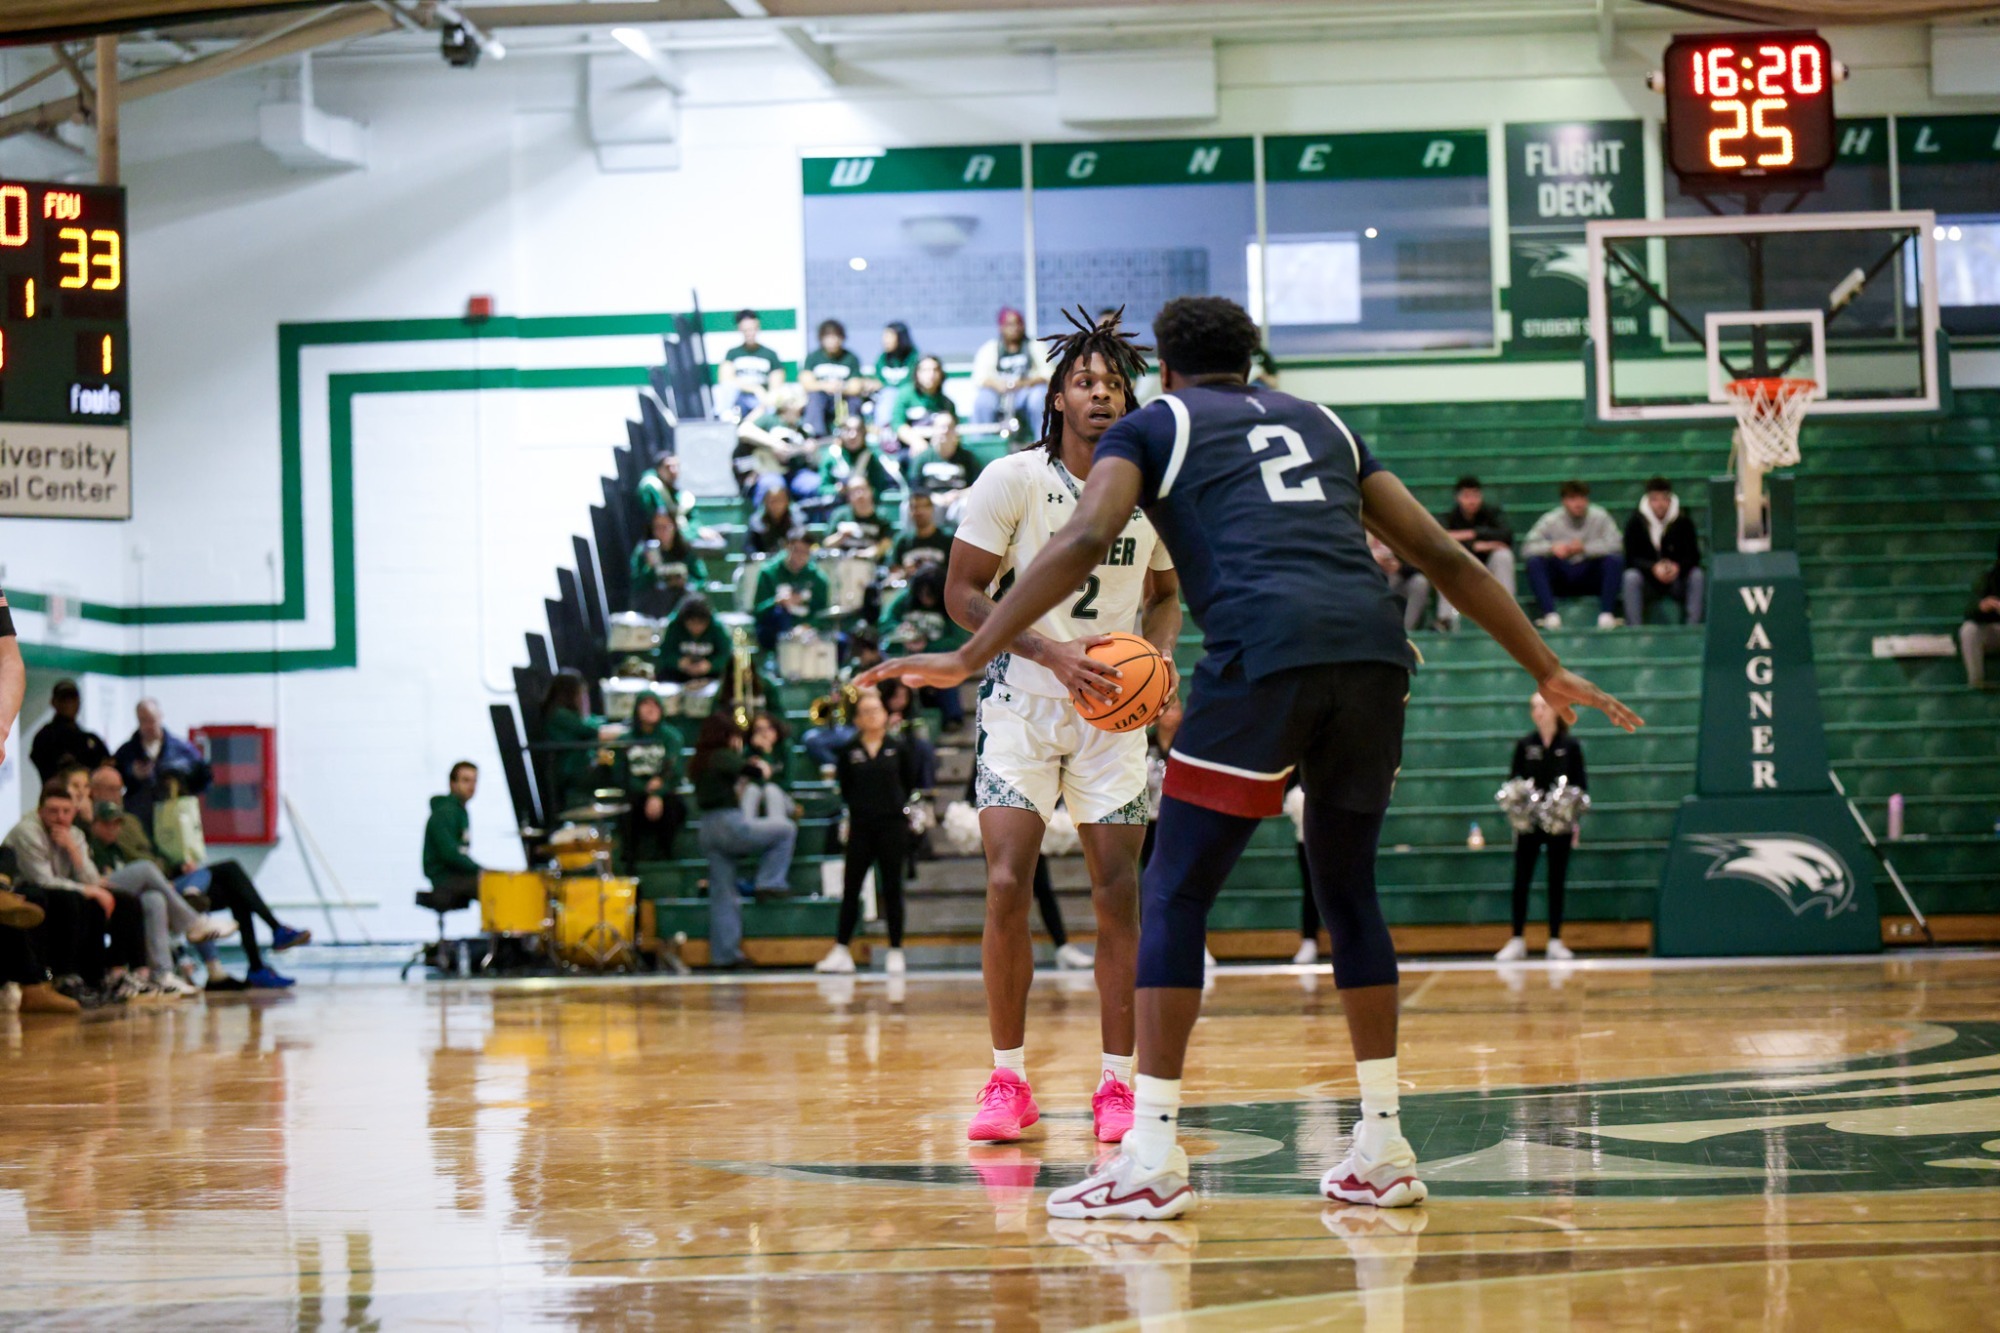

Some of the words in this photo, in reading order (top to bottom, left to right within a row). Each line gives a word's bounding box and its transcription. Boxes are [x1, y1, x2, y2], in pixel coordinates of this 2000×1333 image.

[1692, 45, 1822, 97] 16:20
[1709, 98, 1794, 168] 25
[1525, 139, 1625, 177] FLIGHT
[44, 192, 81, 220] FDU
[1538, 181, 1616, 217] DECK
[58, 227, 120, 291] 33
[25, 277, 35, 318] 1
[1521, 318, 1581, 338] STUDENT
[102, 333, 112, 375] 1
[70, 383, 121, 414] fouls
[1247, 424, 1327, 503] 2
[27, 475, 118, 503] Center
[1071, 573, 1100, 619] 2
[1739, 585, 1778, 789] WAGNER
